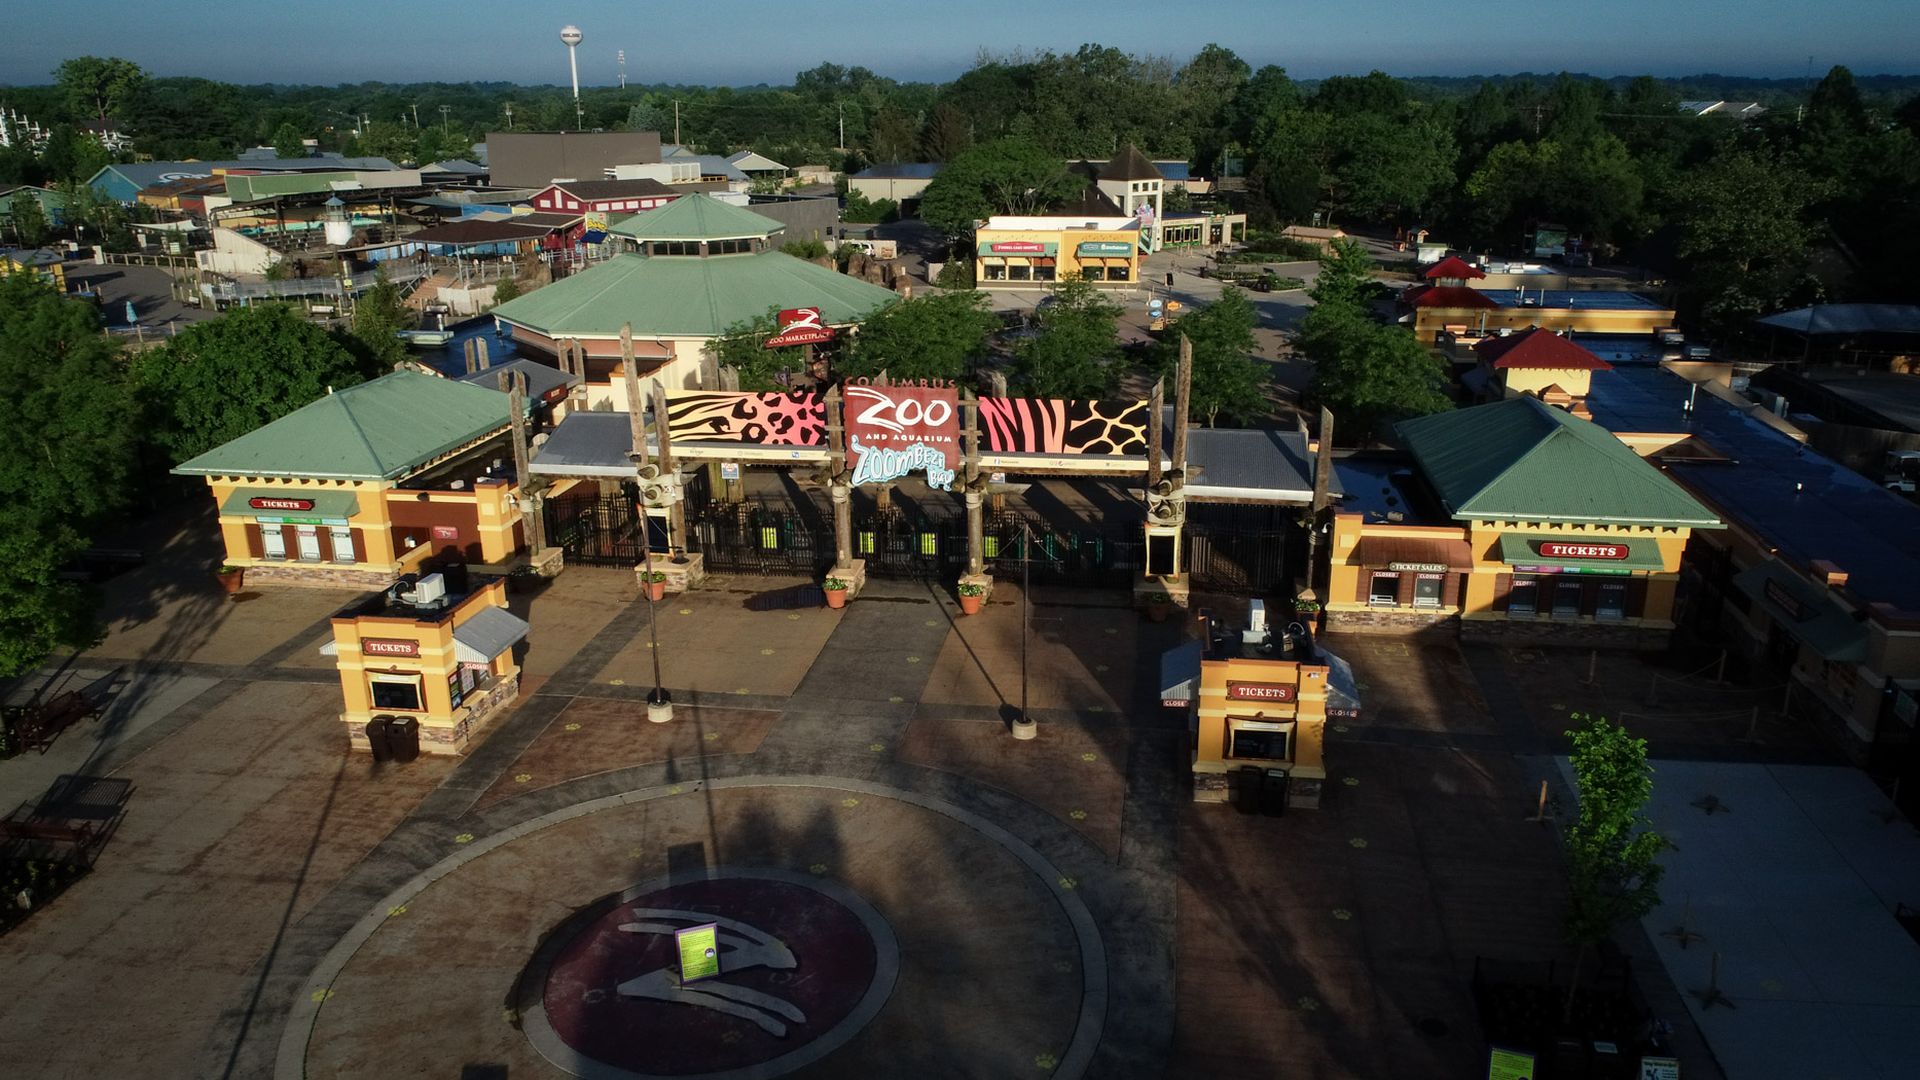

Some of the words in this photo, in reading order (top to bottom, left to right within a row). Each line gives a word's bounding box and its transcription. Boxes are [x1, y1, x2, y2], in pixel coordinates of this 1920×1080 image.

[769, 336, 784, 344] ZOO
[844, 376, 956, 388] COLUMBUS
[847, 386, 952, 434] ZOO
[893, 434, 952, 443] AQUARIUM
[261, 500, 300, 509] TICKETS
[1552, 545, 1617, 556] TICKETS
[1395, 563, 1420, 571] TICKET
[1421, 564, 1442, 572] SALES
[370, 643, 412, 653] TICKETS
[1238, 687, 1286, 698] TICKETS
